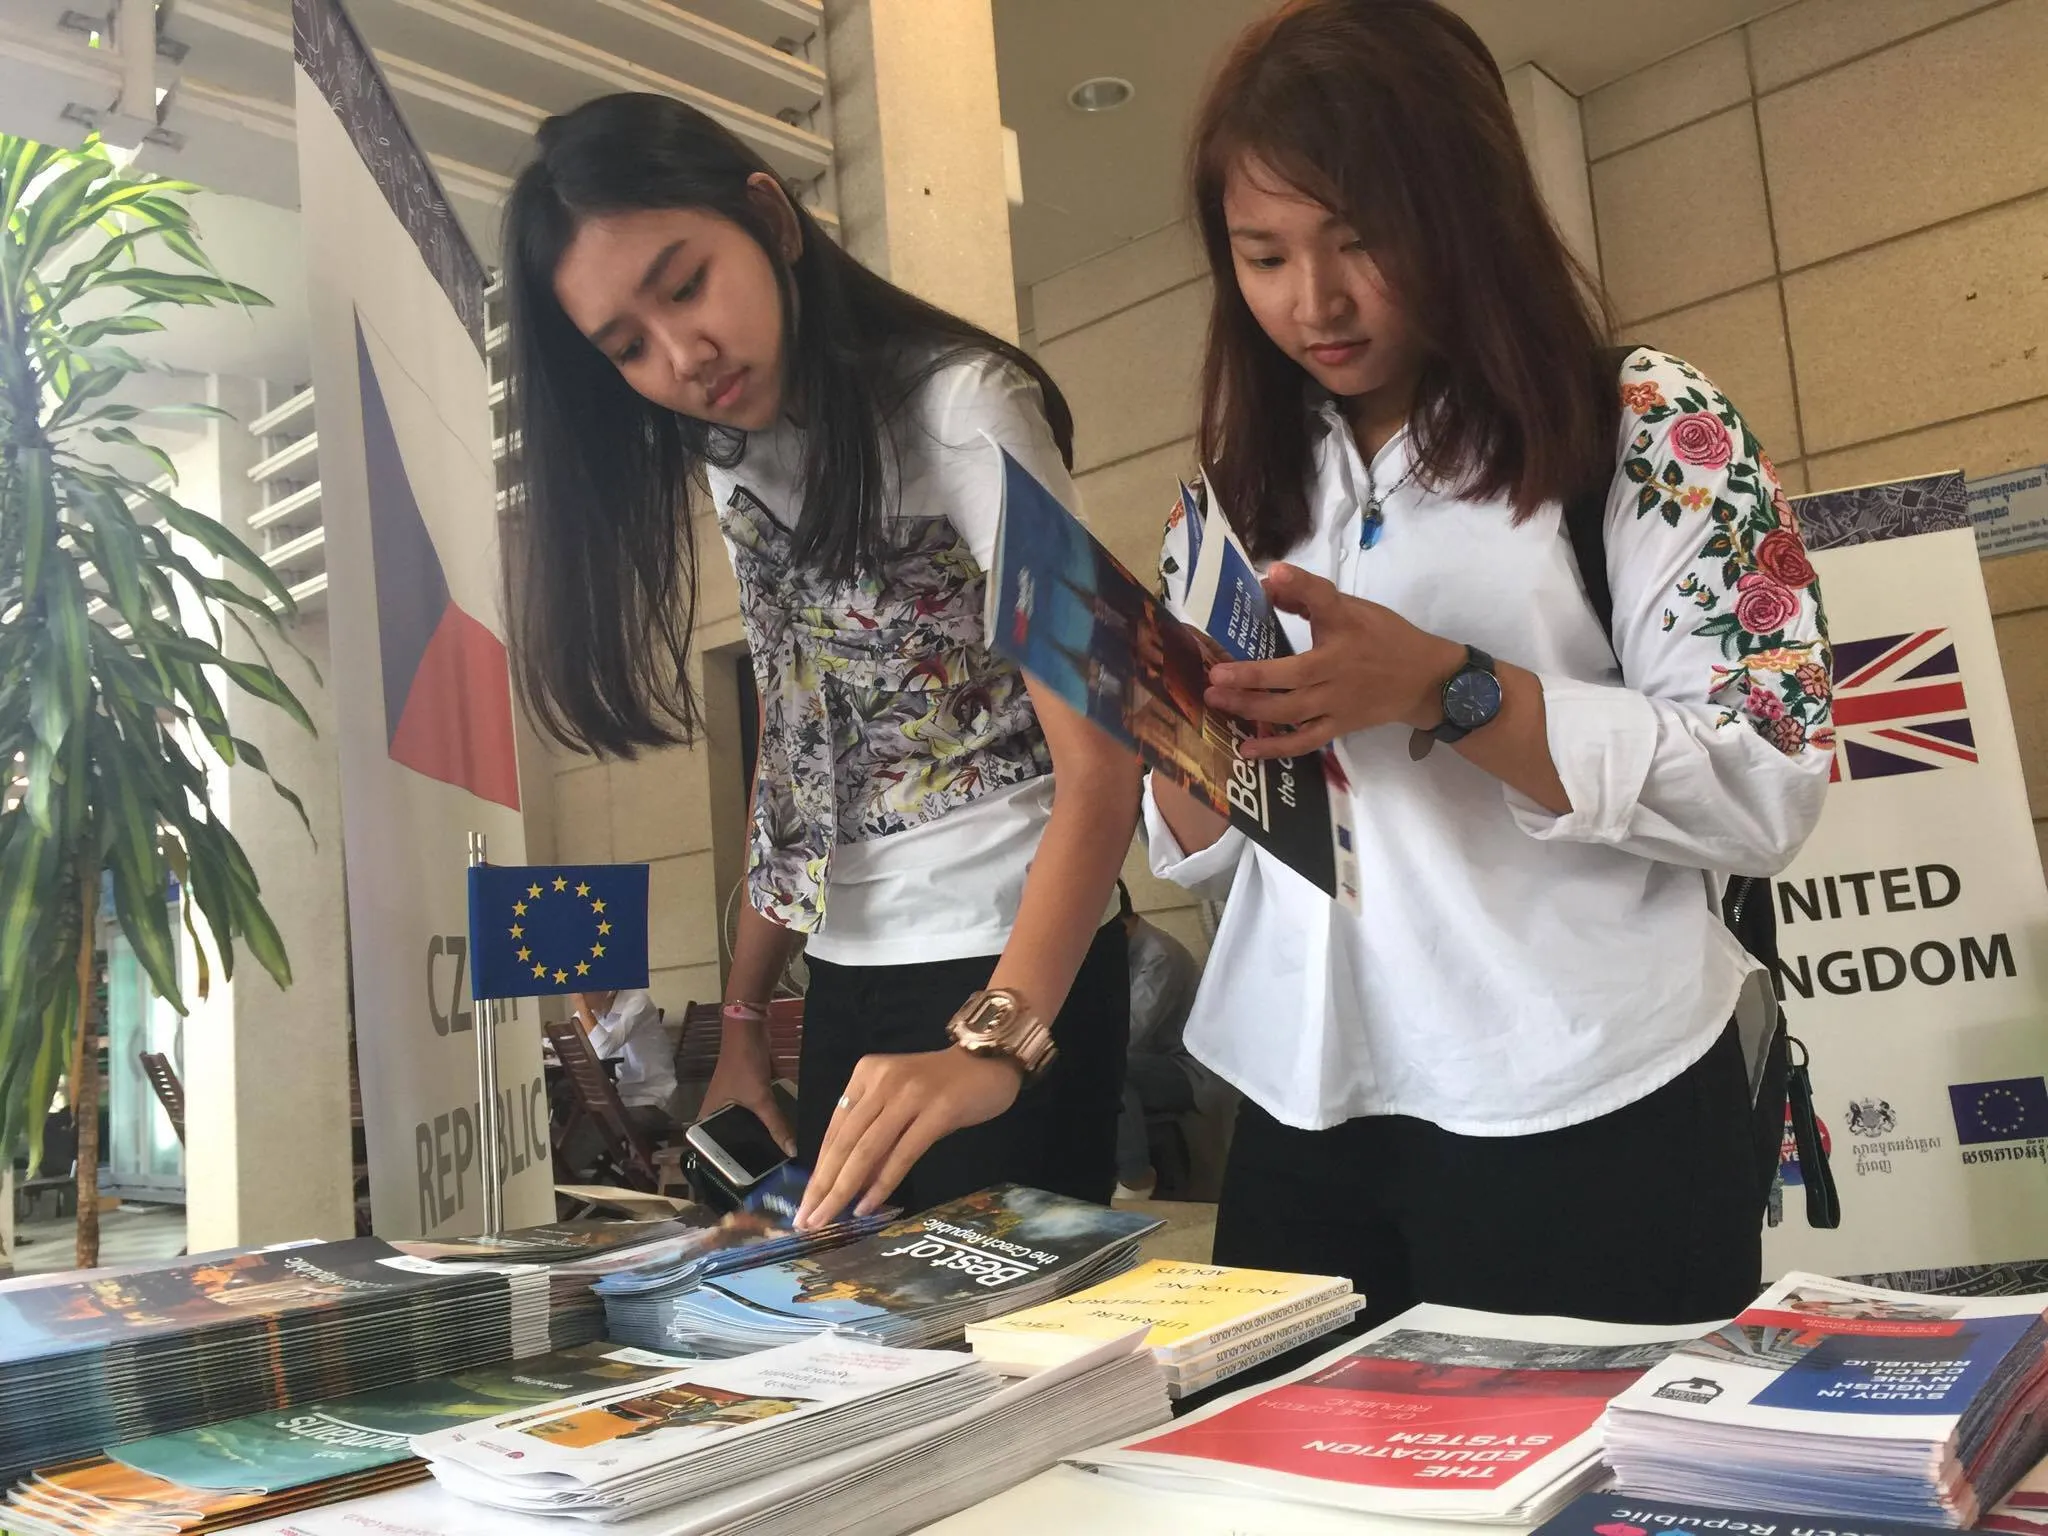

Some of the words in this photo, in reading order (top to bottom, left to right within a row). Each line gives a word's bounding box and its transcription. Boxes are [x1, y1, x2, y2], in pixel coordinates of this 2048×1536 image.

[1227, 593, 1241, 639] STUDY
[1236, 577, 1243, 592] IN
[1237, 592, 1251, 649] ENGLISH
[1247, 642, 1256, 659] IN
[1277, 769, 1296, 808] the
[1777, 864, 1961, 924] NITED
[1777, 933, 2017, 1000] NGDOM
[922, 1218, 986, 1243] Republic
[881, 1240, 945, 1257] of
[981, 1235, 1031, 1257] Czech
[1034, 1251, 1059, 1264] the
[929, 1251, 1029, 1286] Best
[1152, 1267, 1233, 1276] ADULTS
[1268, 1302, 1293, 1320] CHILDREN
[1231, 1320, 1253, 1334] YOUNG
[1255, 1315, 1267, 1325] AND
[1305, 1316, 1315, 1326] FOR
[1210, 1330, 1231, 1344] ADULTS
[1277, 1321, 1303, 1337] CHILDREN
[1240, 1336, 1262, 1351] YOUNG
[1263, 1333, 1275, 1343] AND
[1271, 1337, 1296, 1353] CHILDREN
[1217, 1346, 1239, 1361] ADULTS
[1259, 1348, 1270, 1359] AND
[1816, 1389, 1845, 1397] IN
[1832, 1382, 1952, 1390] ENGLISH
[275, 1417, 410, 1451] untains
[1384, 1432, 1553, 1445] SYSTEM
[1301, 1440, 1530, 1461] EDUCATION
[1413, 1465, 1498, 1478] THE
[1611, 1509, 1777, 1536] Republic
